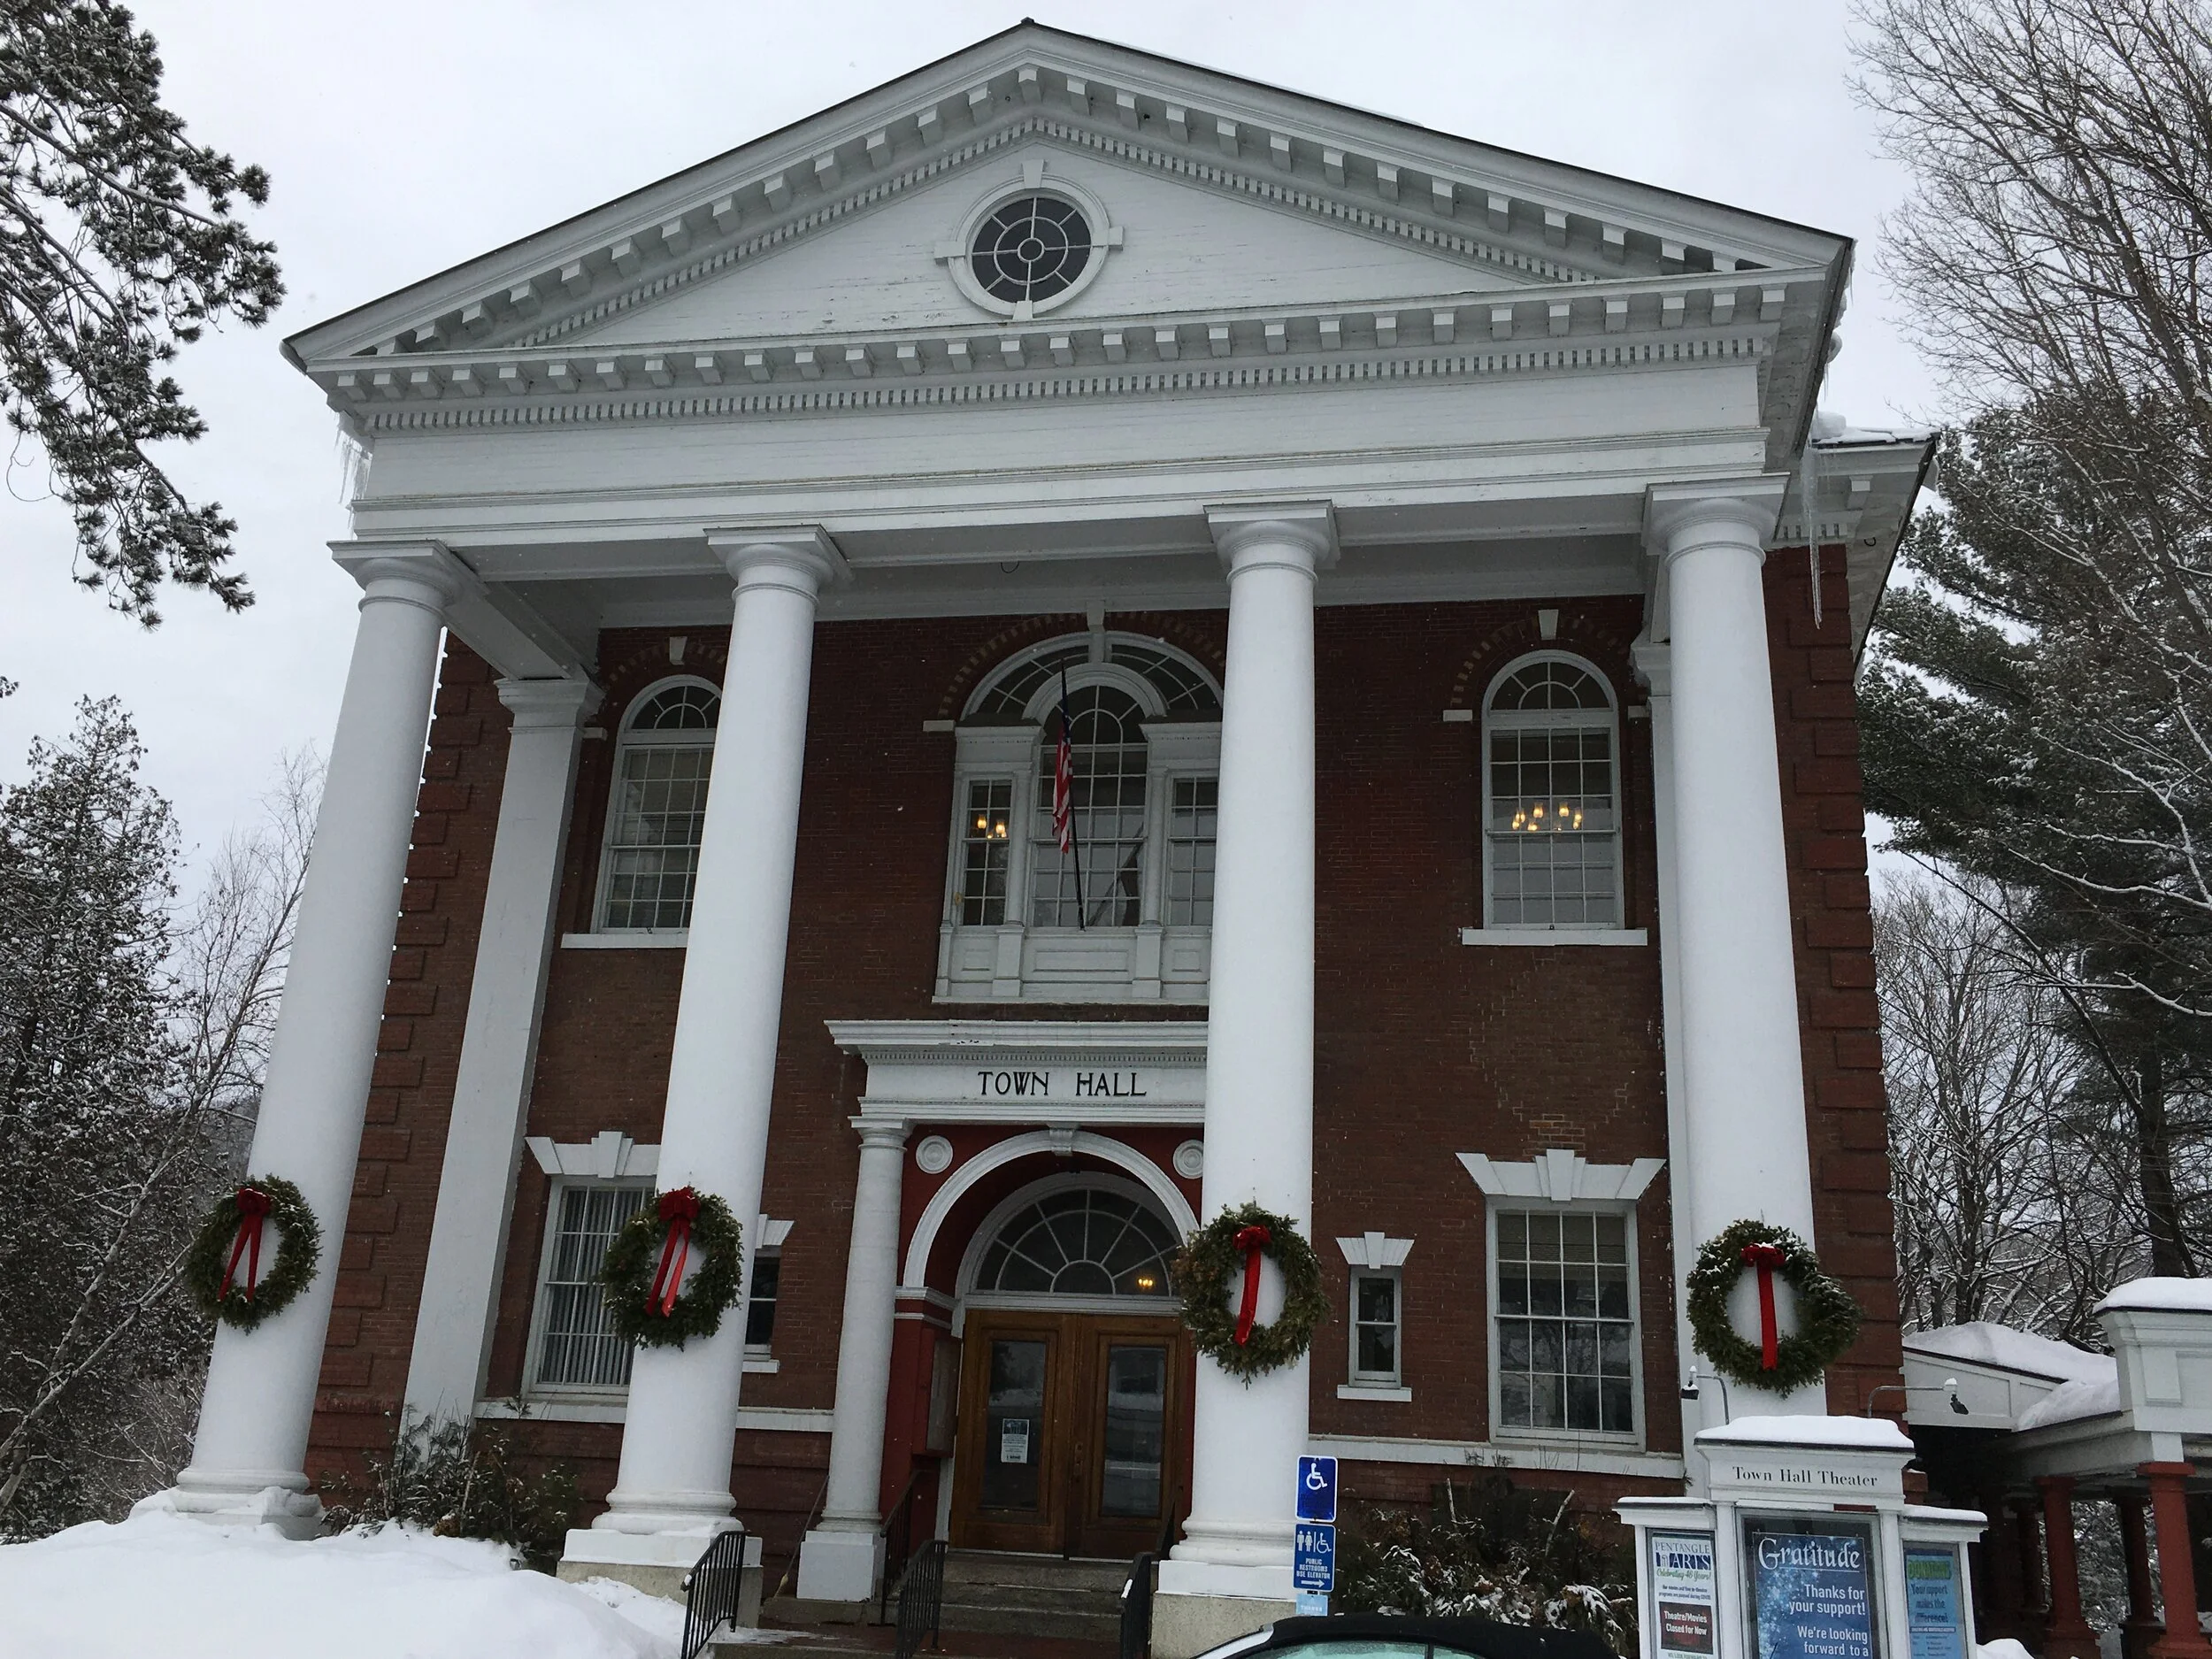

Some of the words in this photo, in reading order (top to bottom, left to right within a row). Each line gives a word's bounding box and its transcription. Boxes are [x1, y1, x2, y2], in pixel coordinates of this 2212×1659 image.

[978, 1071, 1049, 1096] TOWN
[1076, 1072, 1147, 1096] HALL
[1732, 1466, 1772, 1481] Town
[1779, 1469, 1812, 1483] Hall
[1817, 1471, 1878, 1486] Theater
[1655, 1541, 1710, 1555] PENTANGLE
[1758, 1538, 1860, 1570] Gratitude
[1671, 1552, 1711, 1571] ARTS
[1804, 1584, 1846, 1599] Thanks
[1847, 1586, 1865, 1600] for
[1663, 1610, 1708, 1623] Theatre/Movies
[1789, 1601, 1814, 1615] your
[1816, 1602, 1866, 1617] support!
[1665, 1624, 1685, 1633] Closed
[1685, 1625, 1694, 1634] for
[1694, 1626, 1708, 1635] Now
[1797, 1625, 1827, 1639] We're
[1829, 1628, 1868, 1645] looking
[1804, 1641, 1846, 1655] forward
[1850, 1645, 1862, 1656] to
[1863, 1647, 1869, 1656] a
